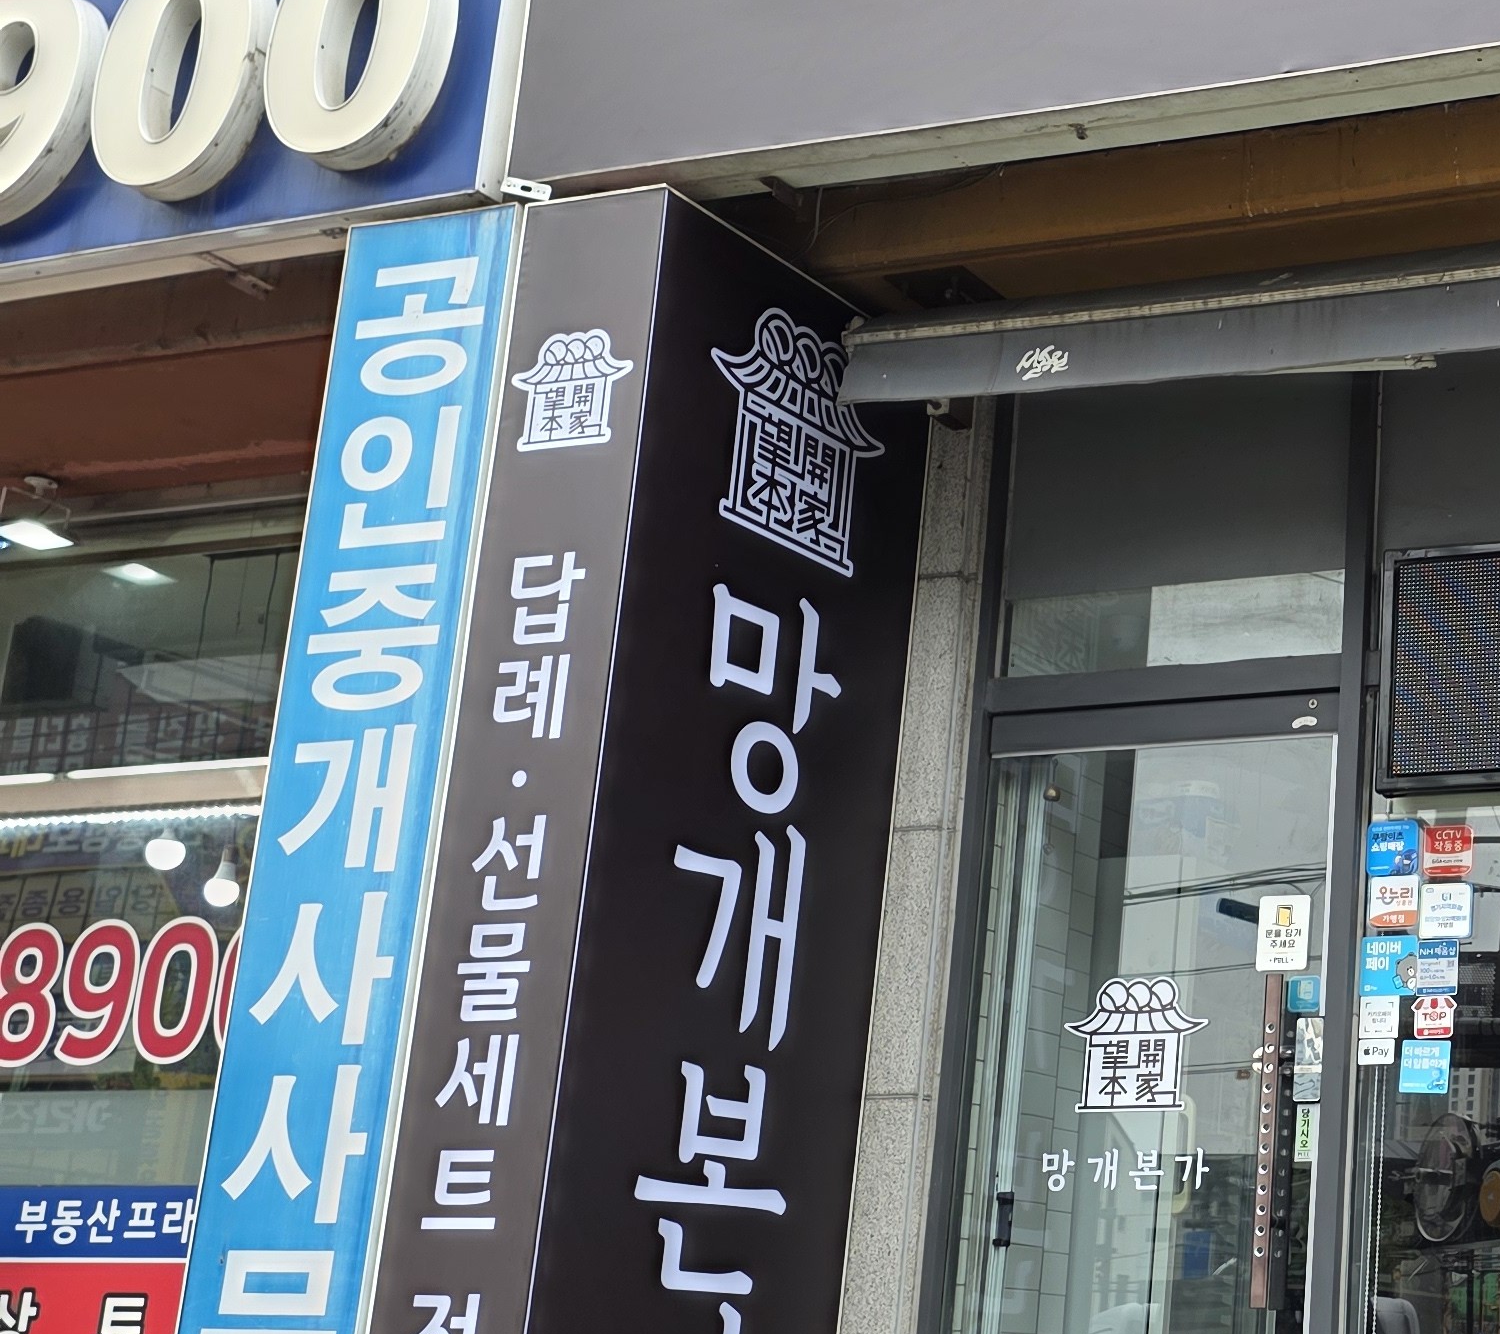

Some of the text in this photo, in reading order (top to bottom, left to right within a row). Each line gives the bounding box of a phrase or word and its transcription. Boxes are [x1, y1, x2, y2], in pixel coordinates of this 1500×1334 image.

[1435, 829, 1463, 840] CCTV
[1434, 840, 1463, 852] 작동중
[1366, 941, 1402, 955] 네이버
[1365, 957, 1390, 971] 페이
[1371, 1046, 1389, 1058] Pay
[1300, 1108, 1310, 1148] 당기시오
[1041, 1147, 1210, 1193] 망개본가
